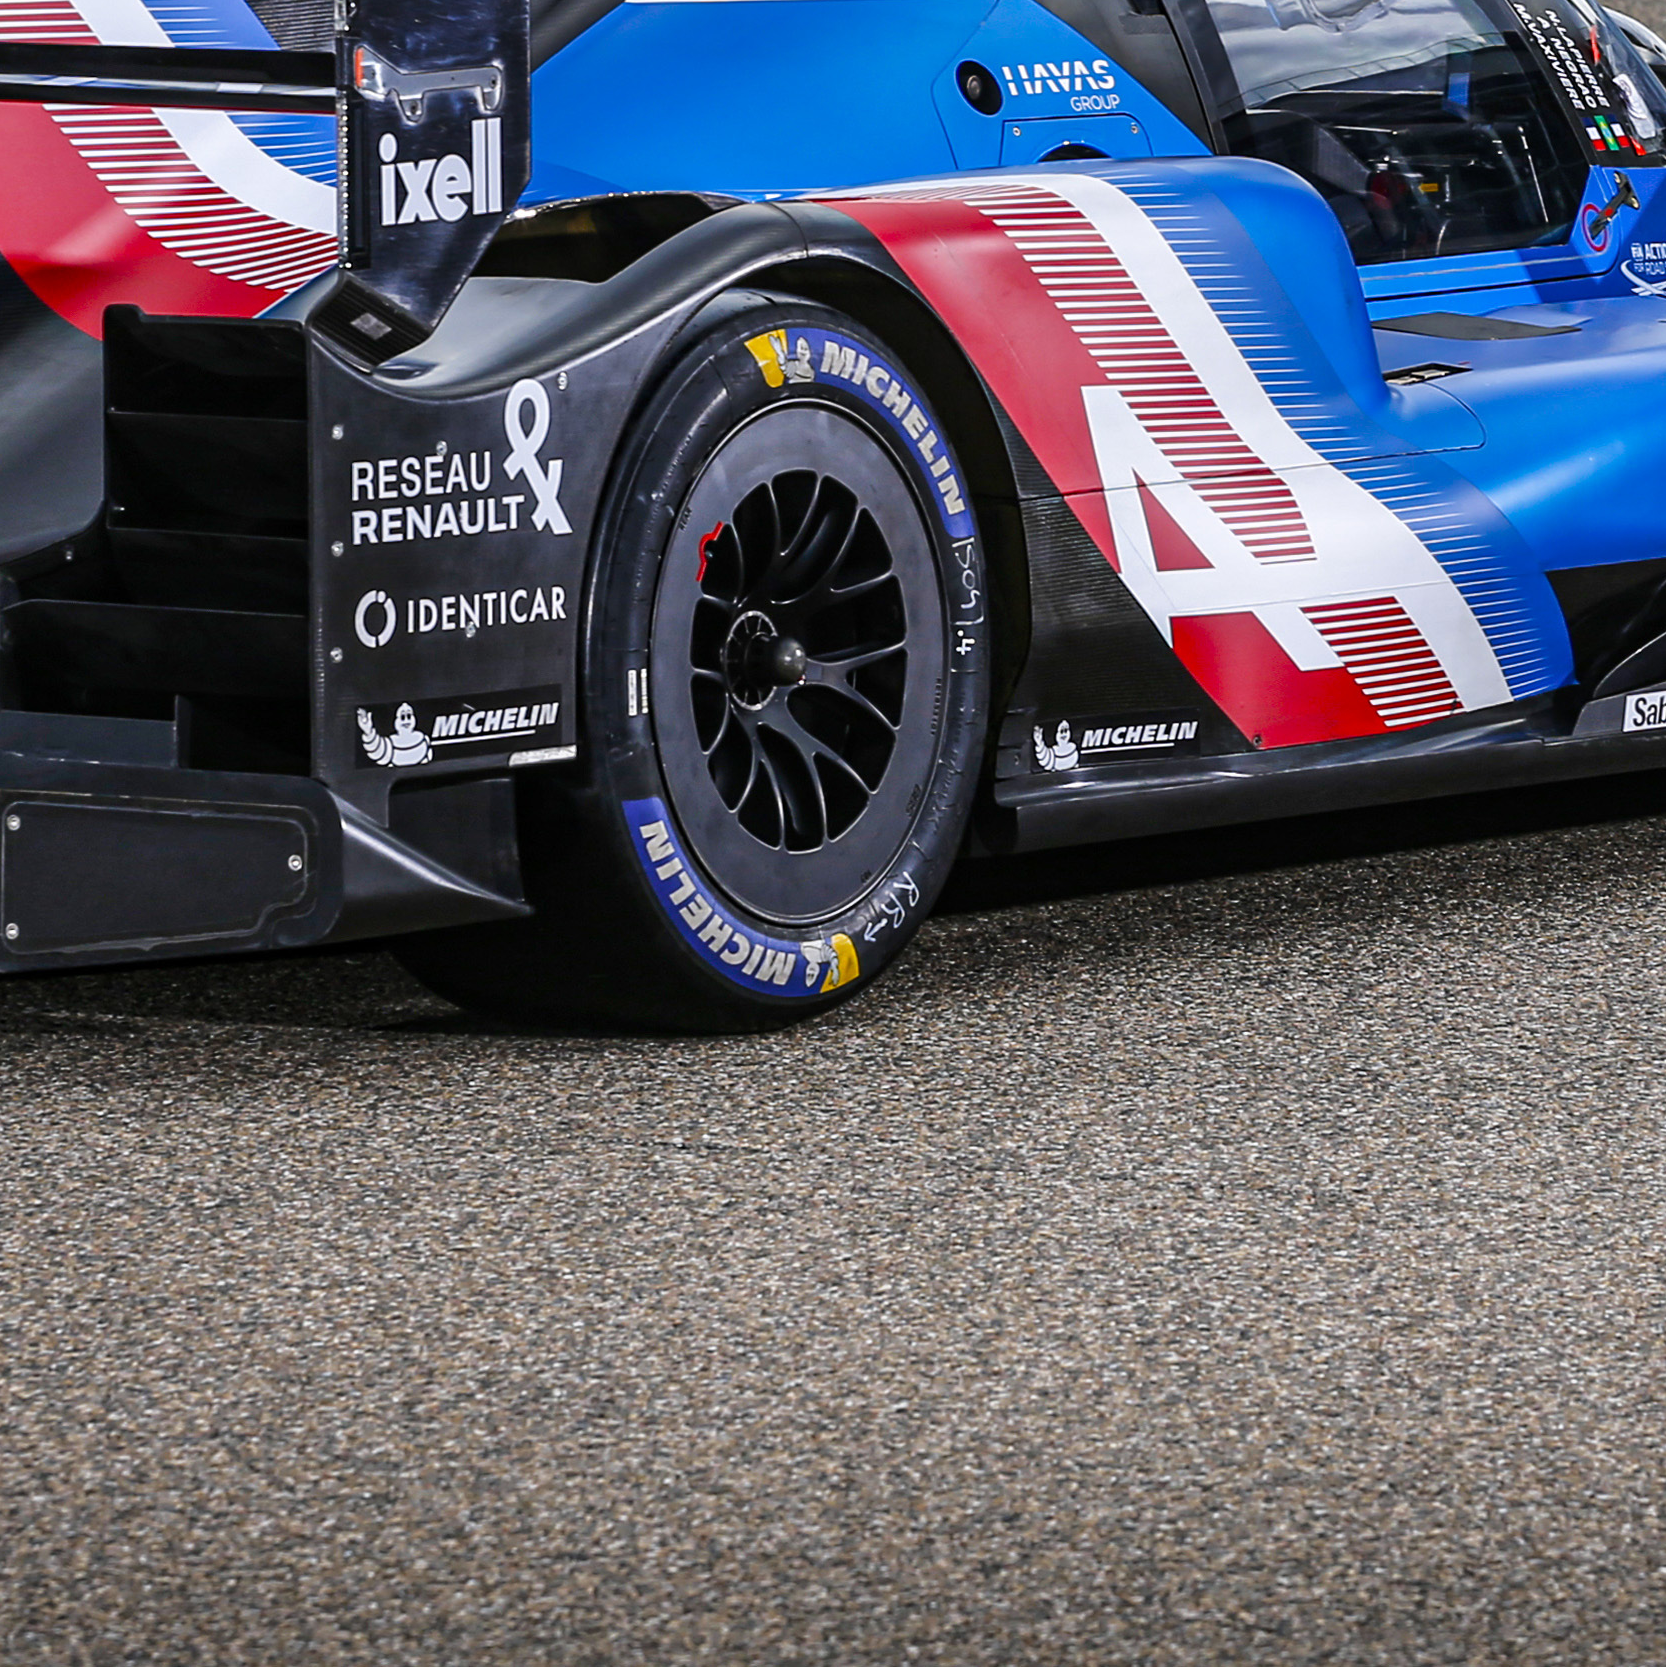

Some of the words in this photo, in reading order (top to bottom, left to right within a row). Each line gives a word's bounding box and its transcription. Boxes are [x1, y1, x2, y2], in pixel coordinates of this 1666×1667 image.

[1001, 59, 1115, 96] HAVAS
[1544, 9, 1611, 108] N.LAPIERRE
[1070, 94, 1121, 112] GROUP
[379, 117, 503, 227] ixell
[820, 340, 966, 516] MICHELIN
[351, 451, 491, 502] RESEAU
[351, 495, 525, 545] RENAULT
[407, 586, 567, 634] IDENTICAR
[432, 702, 559, 738] MICHELIN
[1080, 721, 1198, 746] MICHELIN
[639, 819, 796, 986] MICHELIN
